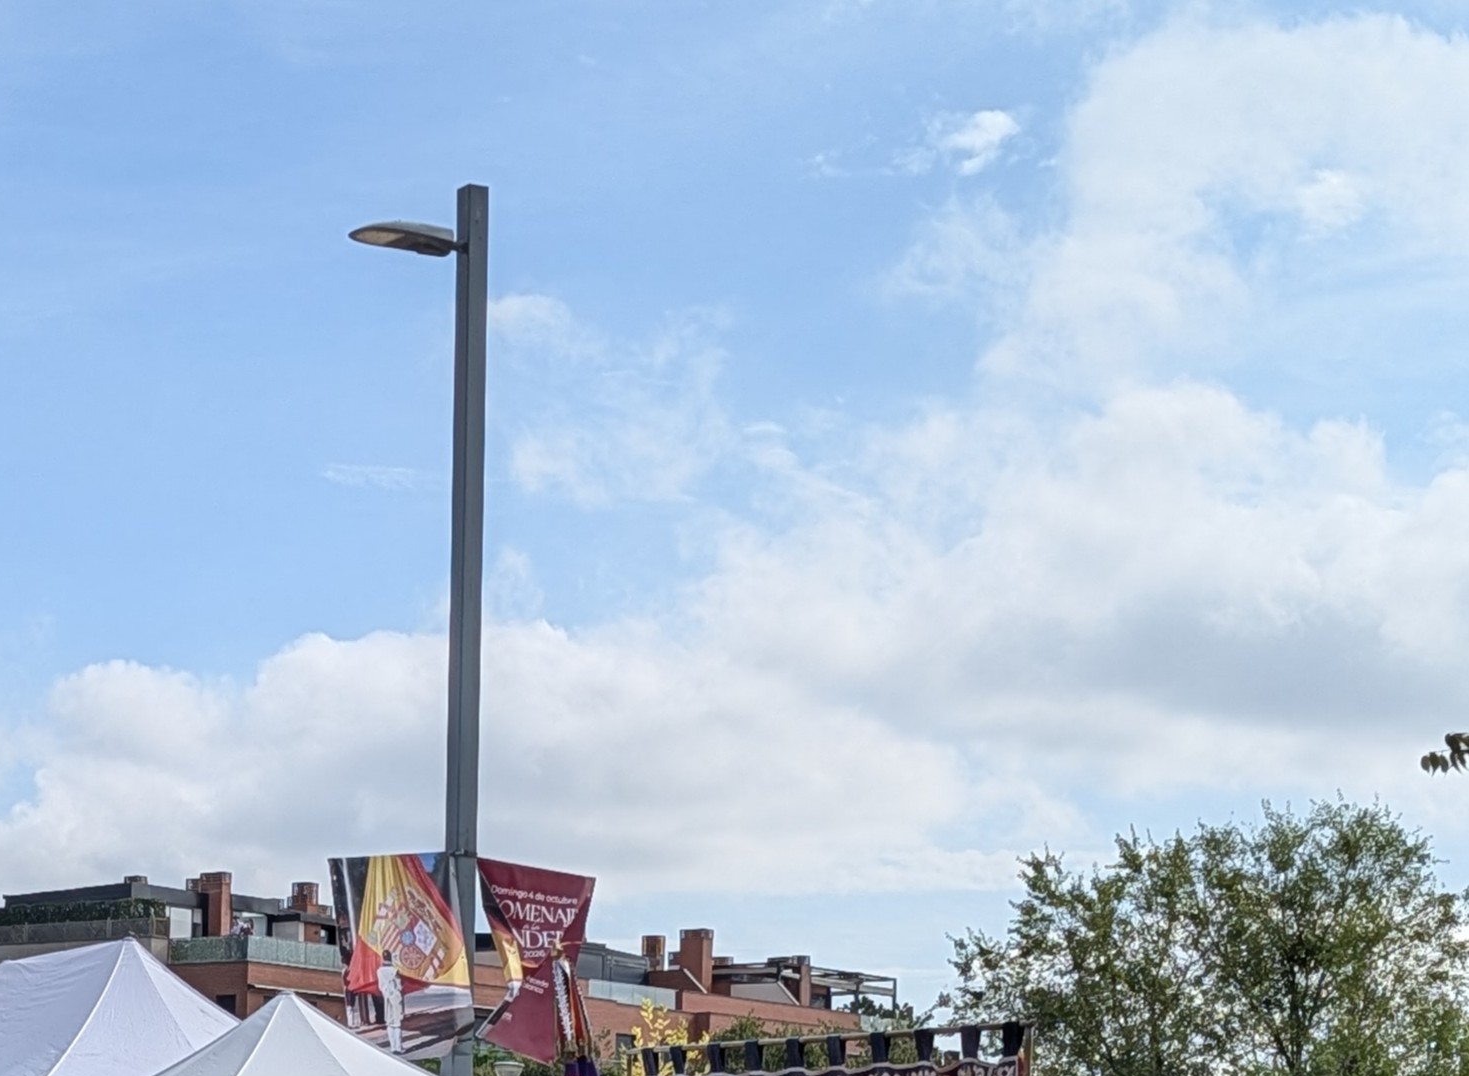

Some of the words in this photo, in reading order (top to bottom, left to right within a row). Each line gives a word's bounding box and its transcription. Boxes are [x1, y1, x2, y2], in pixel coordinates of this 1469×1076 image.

[491, 885, 528, 899] Domingo
[535, 892, 545, 901] de
[546, 896, 578, 905] octubre
[497, 899, 578, 928] OMENAJ
